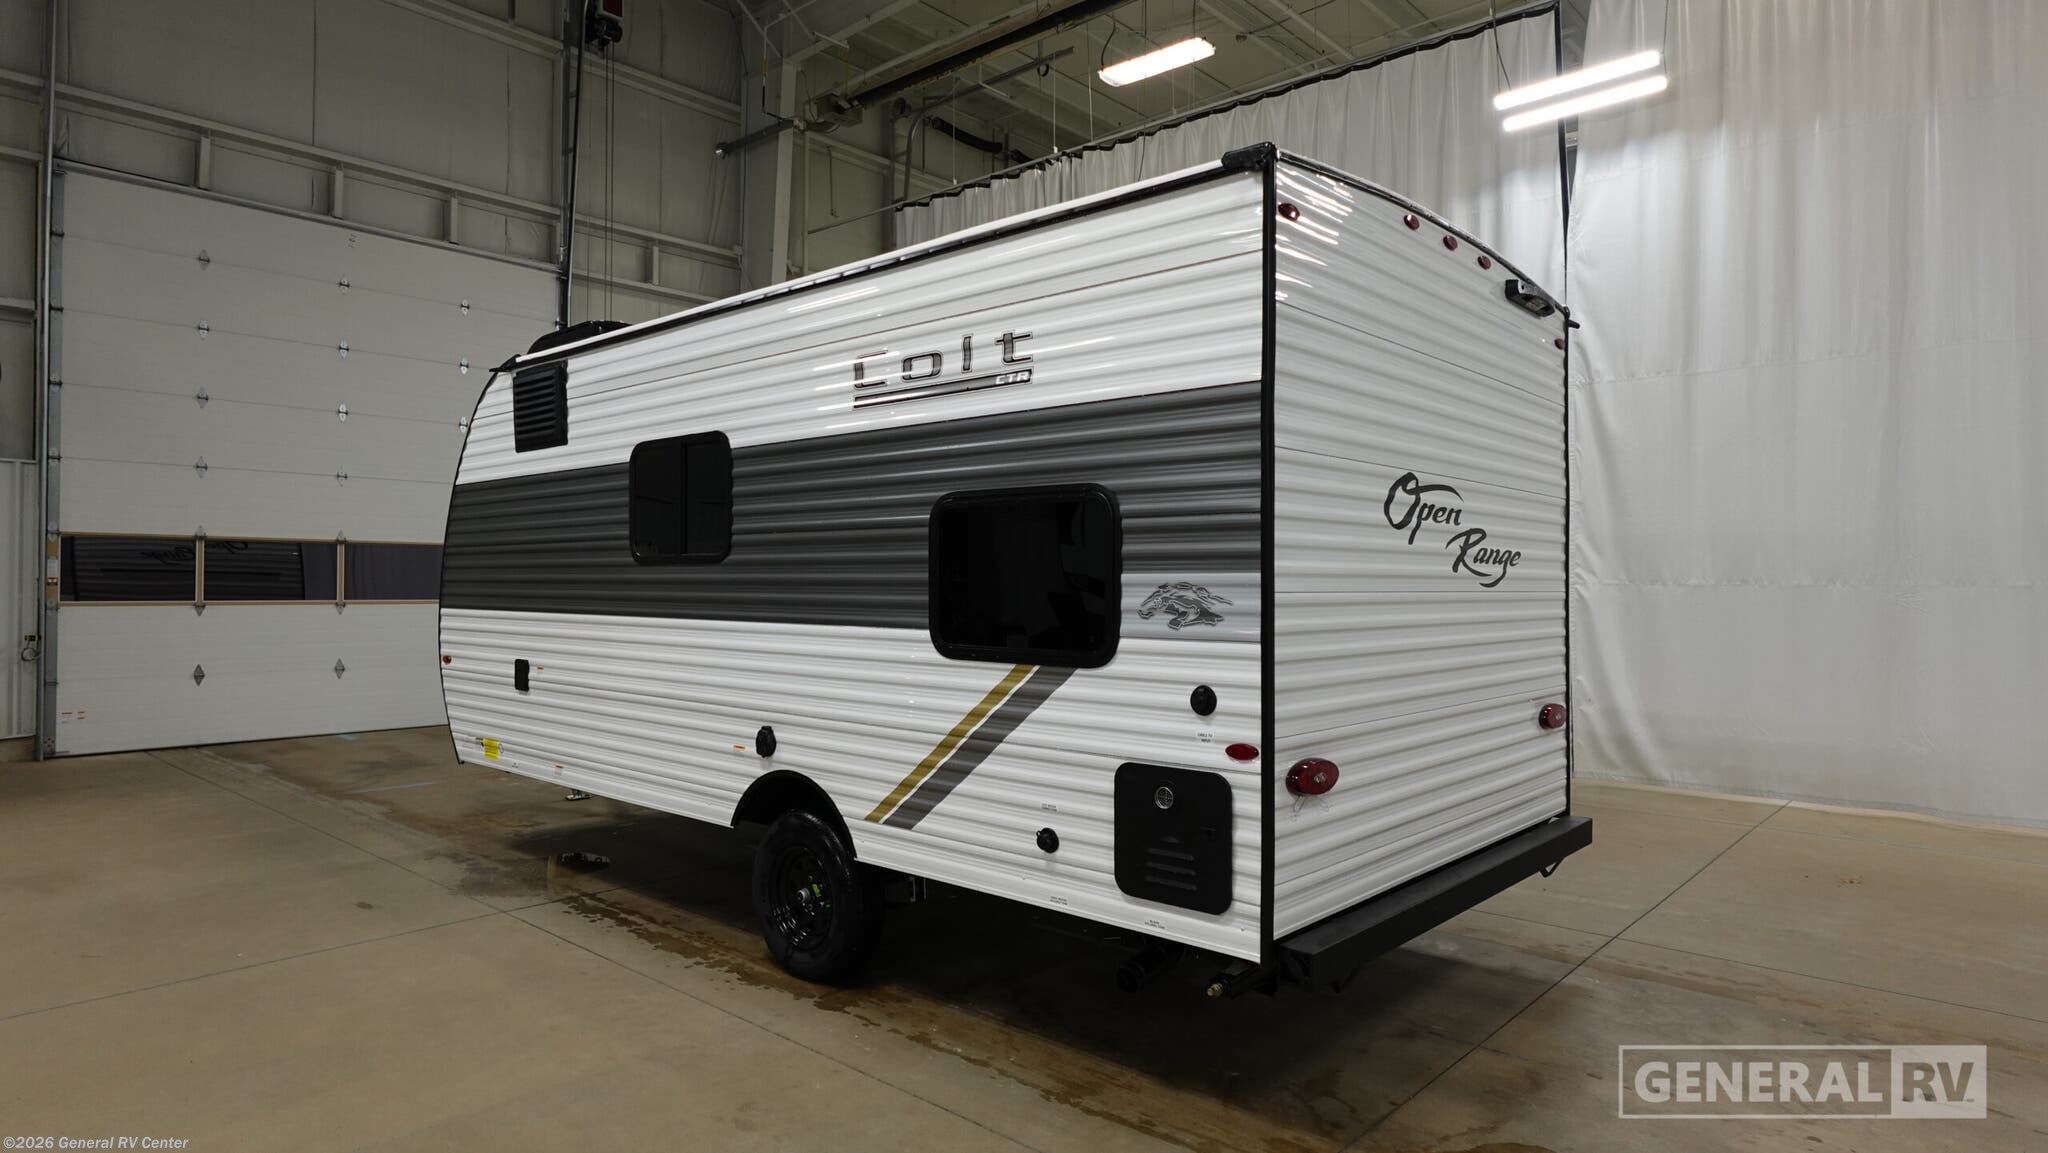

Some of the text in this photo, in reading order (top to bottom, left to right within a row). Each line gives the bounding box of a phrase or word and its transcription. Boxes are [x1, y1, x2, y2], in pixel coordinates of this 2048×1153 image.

[853, 331, 1033, 388] Colt
[1384, 472, 1464, 545] Open
[1445, 528, 1522, 588] Range
